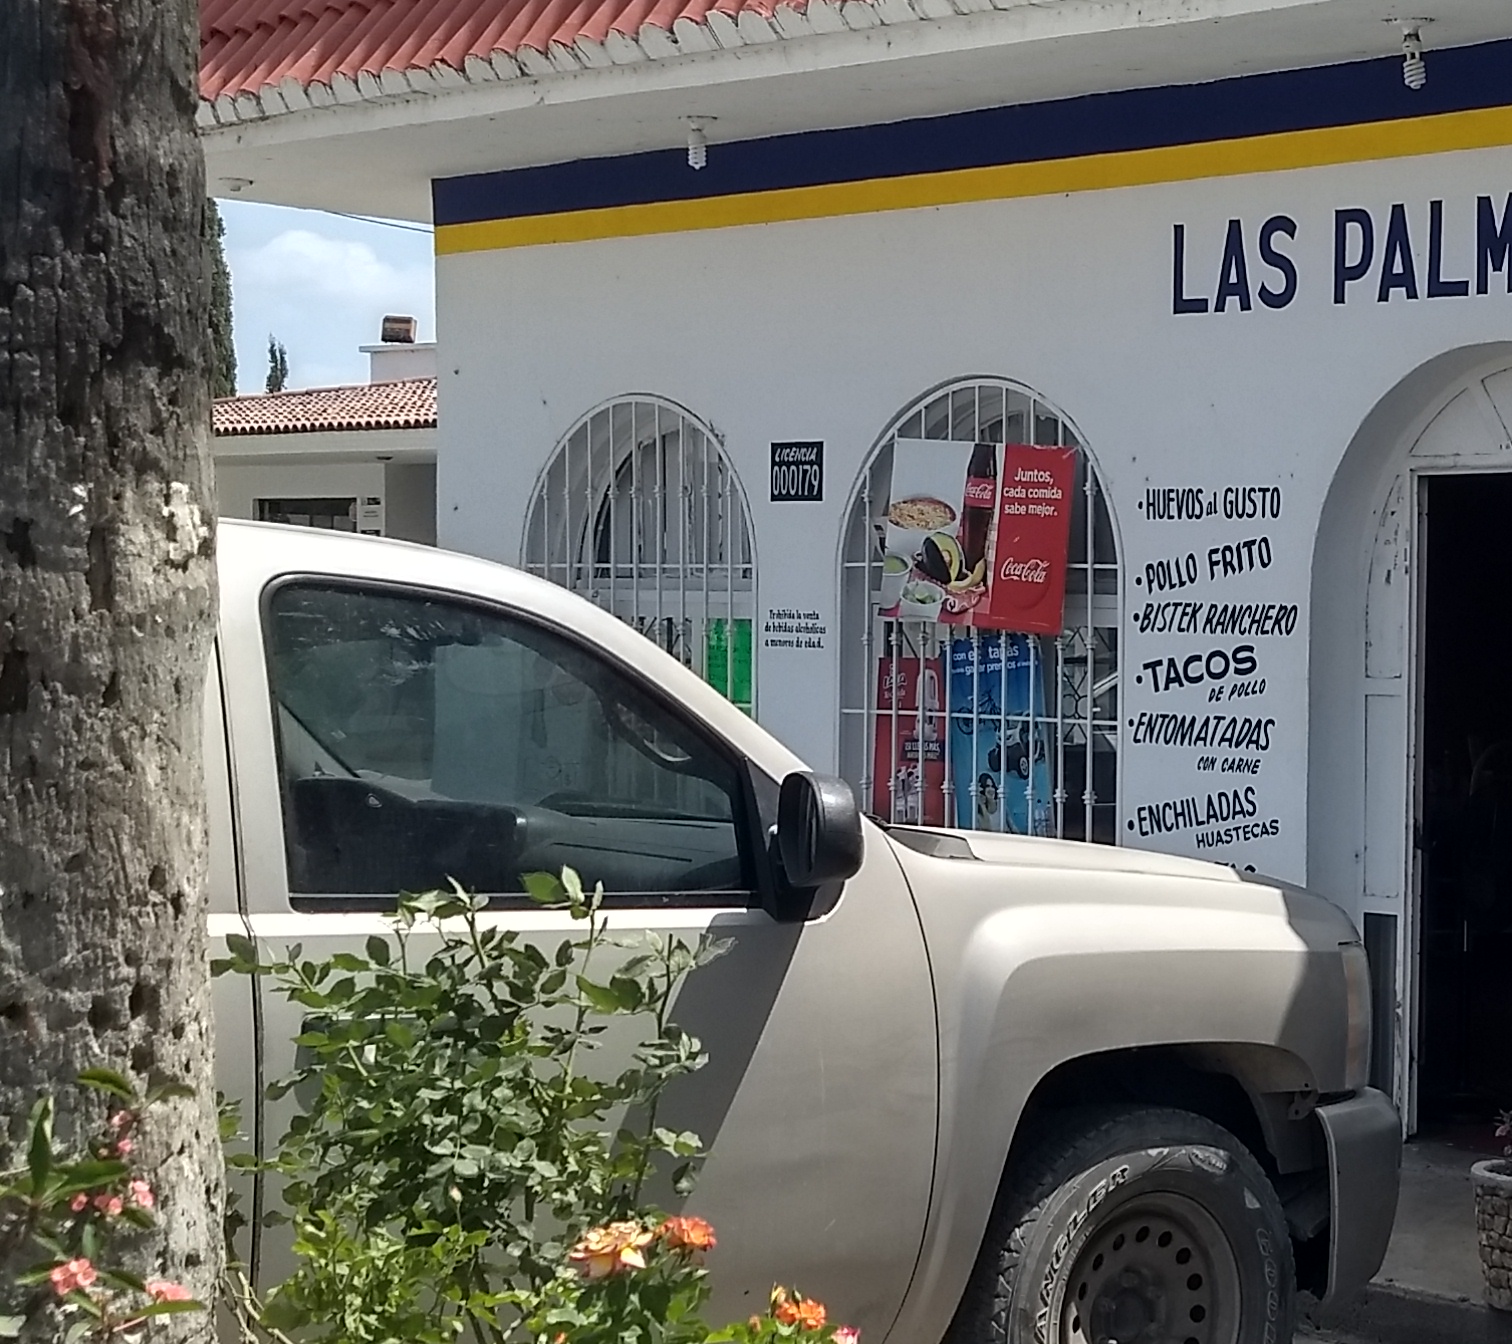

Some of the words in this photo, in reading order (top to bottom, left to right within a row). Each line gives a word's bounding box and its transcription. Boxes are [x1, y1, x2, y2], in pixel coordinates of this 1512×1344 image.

[1172, 215, 1298, 315] LAS
[775, 447, 817, 462] LICENCIA
[772, 465, 820, 495] 000179
[1014, 467, 1054, 485] Juntos,
[1003, 486, 1026, 498] cada
[1027, 487, 1062, 500] comida
[1146, 487, 1204, 520] HUEVOS
[1206, 491, 1218, 516] al
[1223, 487, 1281, 519] GUSTO
[1004, 502, 1026, 515] sabe
[1028, 503, 1058, 518] mejor.
[1145, 553, 1198, 595] POLLO
[1207, 536, 1272, 581] FRITO
[765, 621, 772, 632] de
[1139, 602, 1203, 634] BISTEK
[1203, 603, 1298, 636] RANCHERO
[796, 636, 802, 648] de
[1143, 645, 1257, 693] TACOS
[1208, 686, 1224, 703] DE
[1228, 678, 1266, 701] POLLO
[1133, 712, 1275, 751] ENTOMATADAS
[1197, 756, 1217, 771] CON
[1221, 758, 1261, 775] CARNE
[1137, 786, 1257, 837] ENCHILADAS
[1196, 819, 1279, 849] HUASTECAS
